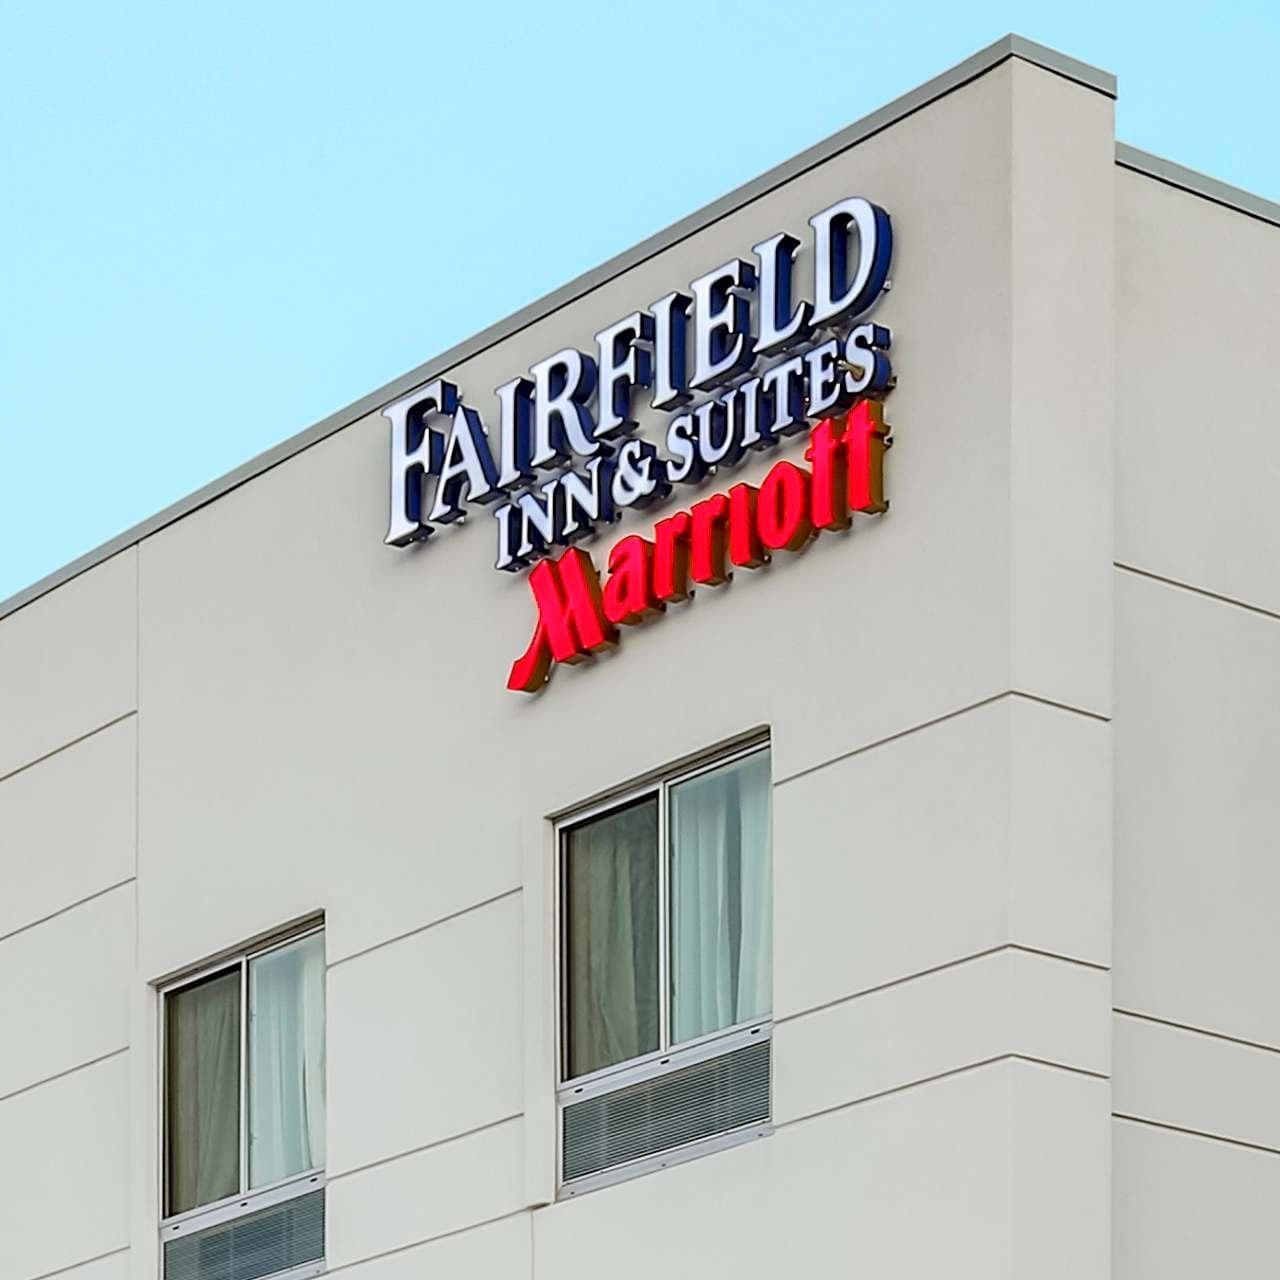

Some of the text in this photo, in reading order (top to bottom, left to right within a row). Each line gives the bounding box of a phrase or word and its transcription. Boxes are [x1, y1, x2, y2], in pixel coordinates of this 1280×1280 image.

[381, 196, 893, 546] FAIRFIELD
[494, 460, 613, 572] INN
[666, 322, 894, 485] SUITES
[506, 398, 890, 692] Marriott
